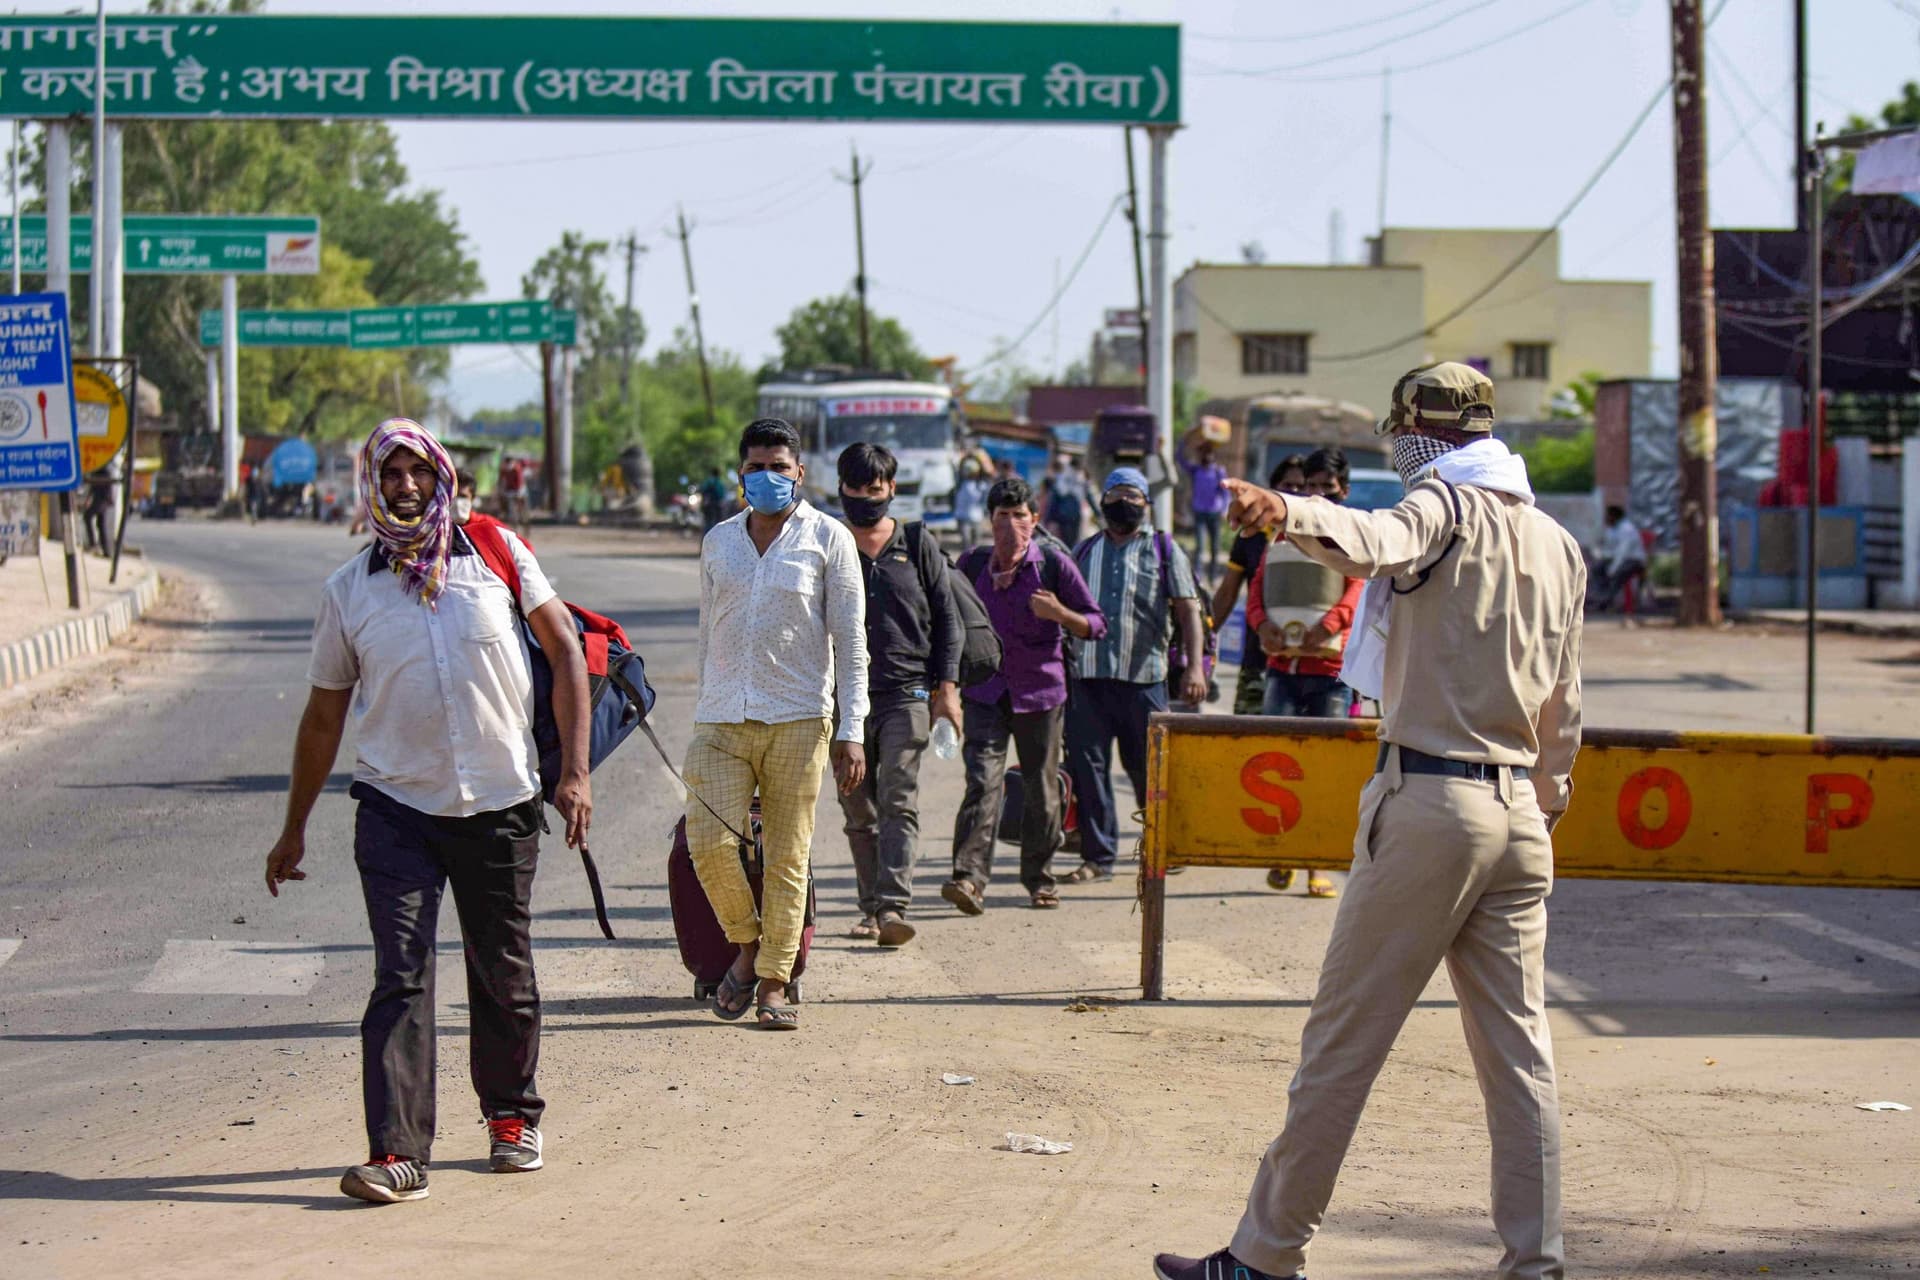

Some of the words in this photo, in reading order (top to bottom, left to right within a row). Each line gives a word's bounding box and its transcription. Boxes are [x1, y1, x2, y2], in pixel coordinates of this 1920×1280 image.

[21, 66, 156, 101] करता
[386, 55, 504, 101] मिश्रा
[707, 58, 837, 104] जिला
[854, 64, 1026, 107] पंचायत
[158, 254, 211, 267] NAGPUR
[12, 337, 53, 355] TREAT
[0, 355, 38, 372] GHAT
